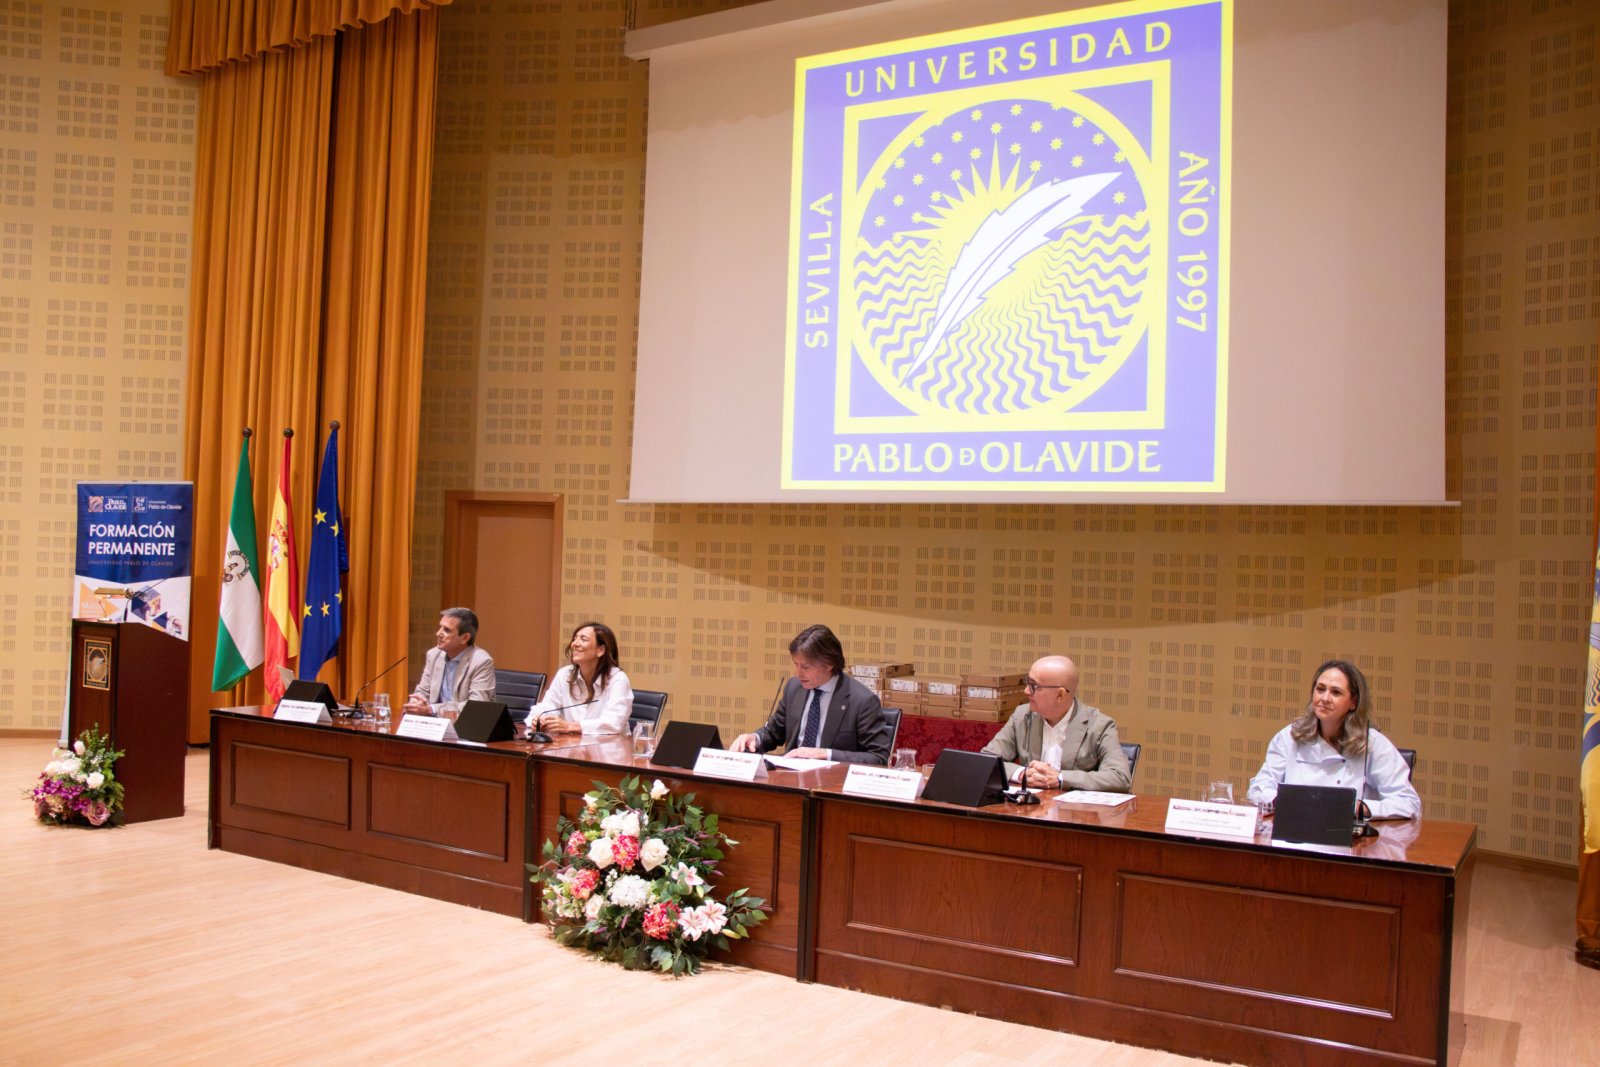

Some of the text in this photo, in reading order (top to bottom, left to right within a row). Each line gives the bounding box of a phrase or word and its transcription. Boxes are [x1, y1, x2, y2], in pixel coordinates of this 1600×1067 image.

[844, 20, 1173, 98] UNIVERSIDAD
[1176, 151, 1216, 333] AÑO 1997
[805, 192, 833, 349] SEVILLA
[833, 442, 954, 473] PABLO
[979, 440, 1162, 473] OLAVIDE
[88, 541, 176, 556] PERMANENTE
[89, 521, 175, 538] FORMACIÓN
